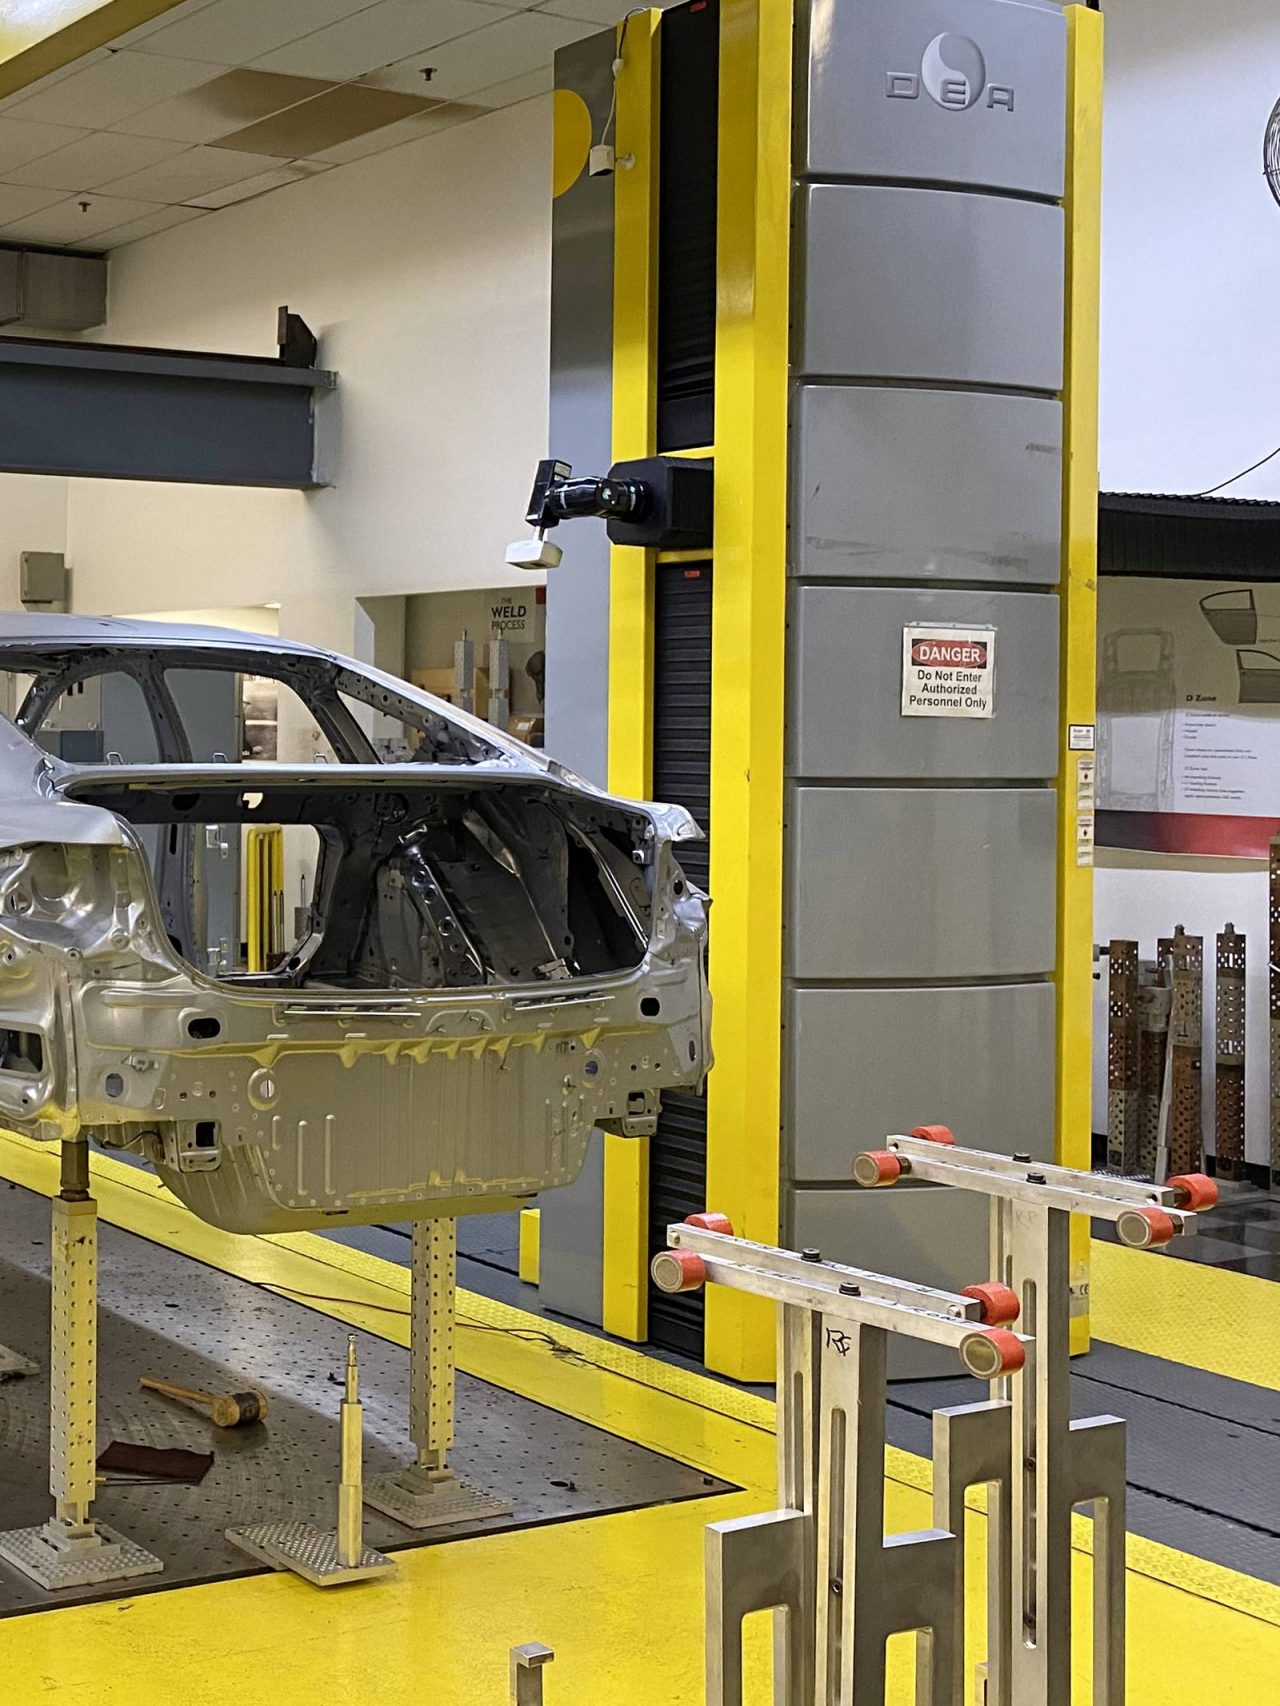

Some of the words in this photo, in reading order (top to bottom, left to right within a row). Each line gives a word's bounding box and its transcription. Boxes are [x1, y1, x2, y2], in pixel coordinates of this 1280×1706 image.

[884, 71, 1015, 112] DEA
[491, 605, 527, 618] WELD
[919, 646, 980, 662] DANGER
[917, 669, 932, 680] Do
[935, 670, 953, 681] Not
[956, 671, 982, 682] Enter
[921, 682, 978, 695] Authorized
[909, 695, 962, 707] Personnel
[965, 697, 987, 711] Only
